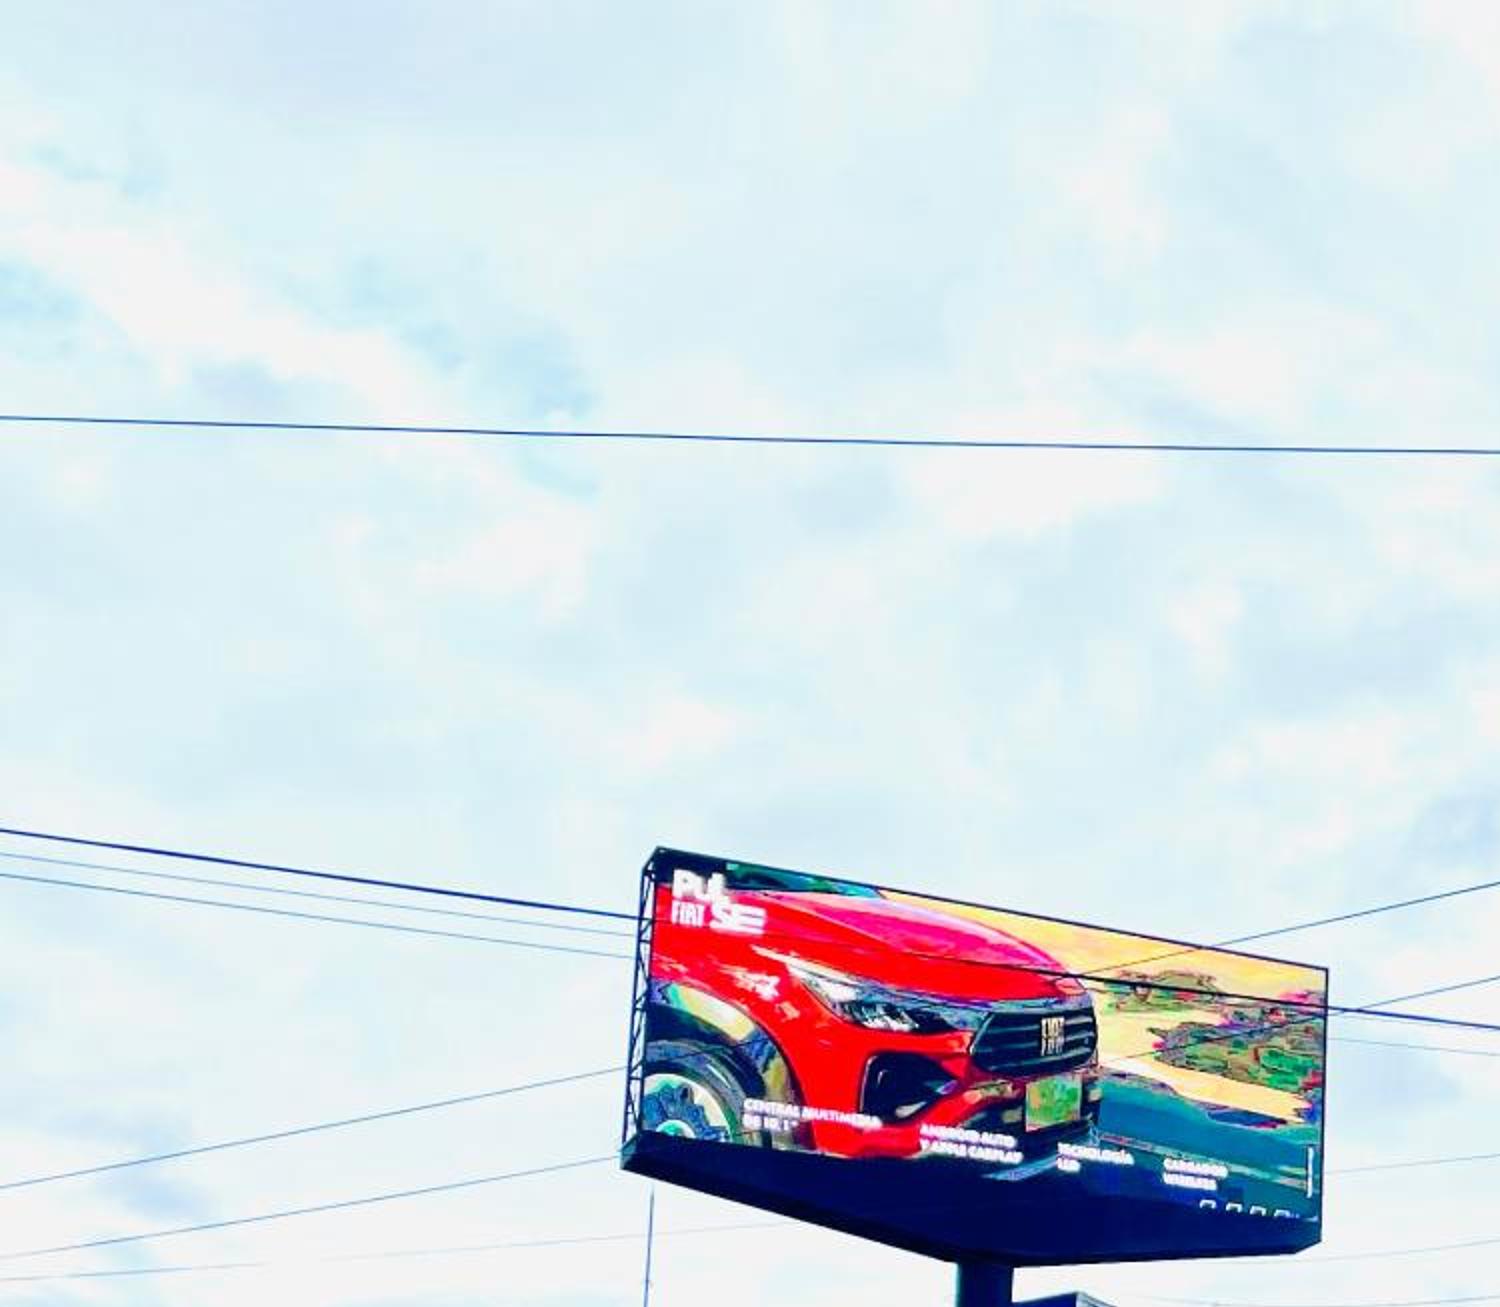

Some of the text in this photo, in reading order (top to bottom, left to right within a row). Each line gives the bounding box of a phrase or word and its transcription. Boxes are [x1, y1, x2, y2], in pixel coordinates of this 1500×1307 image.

[671, 900, 705, 927] FIAT
[742, 1113, 761, 1128] DE
[744, 1098, 883, 1131] CENTRAL MULTIMEDIA
[920, 1123, 1018, 1149] ANDROID AUTO
